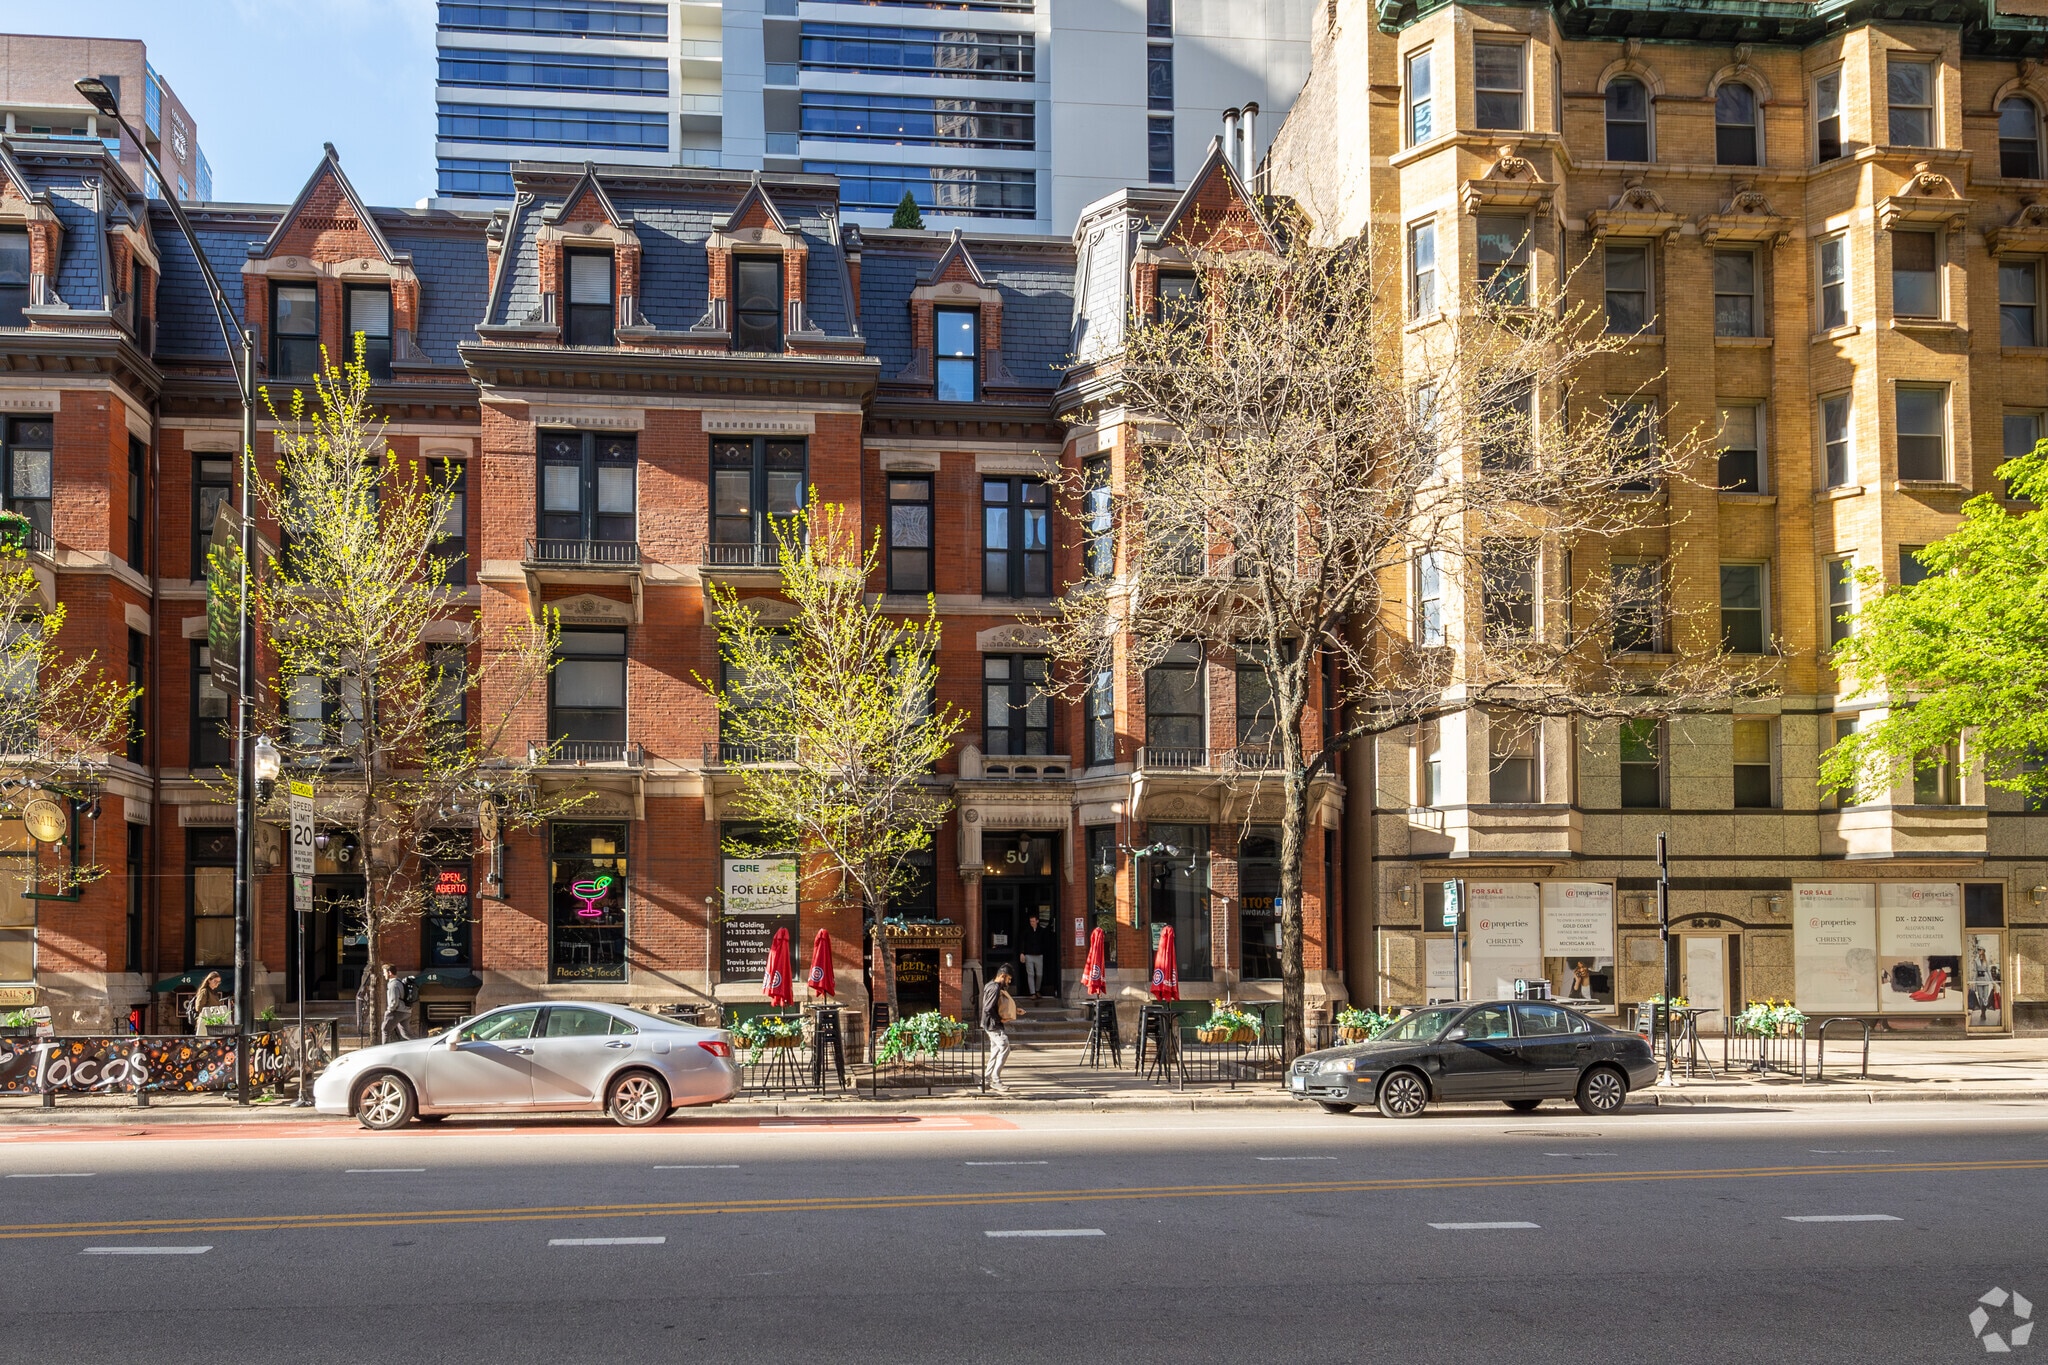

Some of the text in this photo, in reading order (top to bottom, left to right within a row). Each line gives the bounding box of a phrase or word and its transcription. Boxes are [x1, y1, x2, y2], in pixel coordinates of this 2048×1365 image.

[291, 782, 313, 796] SCHOOL
[34, 801, 59, 814] FANTASY
[293, 800, 312, 812] SPEED
[34, 815, 60, 829] NAILS
[294, 812, 311, 823] LIMIT
[293, 825, 313, 847] 20
[325, 848, 351, 862] 46
[1006, 850, 1030, 864] 50
[731, 864, 760, 873] CBRE
[440, 872, 461, 882] OPEN
[435, 884, 467, 893] ABIERTO
[731, 885, 789, 895] FOR LEASE
[1565, 888, 1610, 898] @properties
[1911, 889, 1954, 900] @properties
[739, 922, 765, 930] Golding
[1479, 919, 1529, 930] @properties
[1809, 917, 1857, 929] @properties
[556, 966, 621, 977] Flaco's Tacos
[0, 990, 24, 998] AILS
[31, 1042, 149, 1087] Tacos
